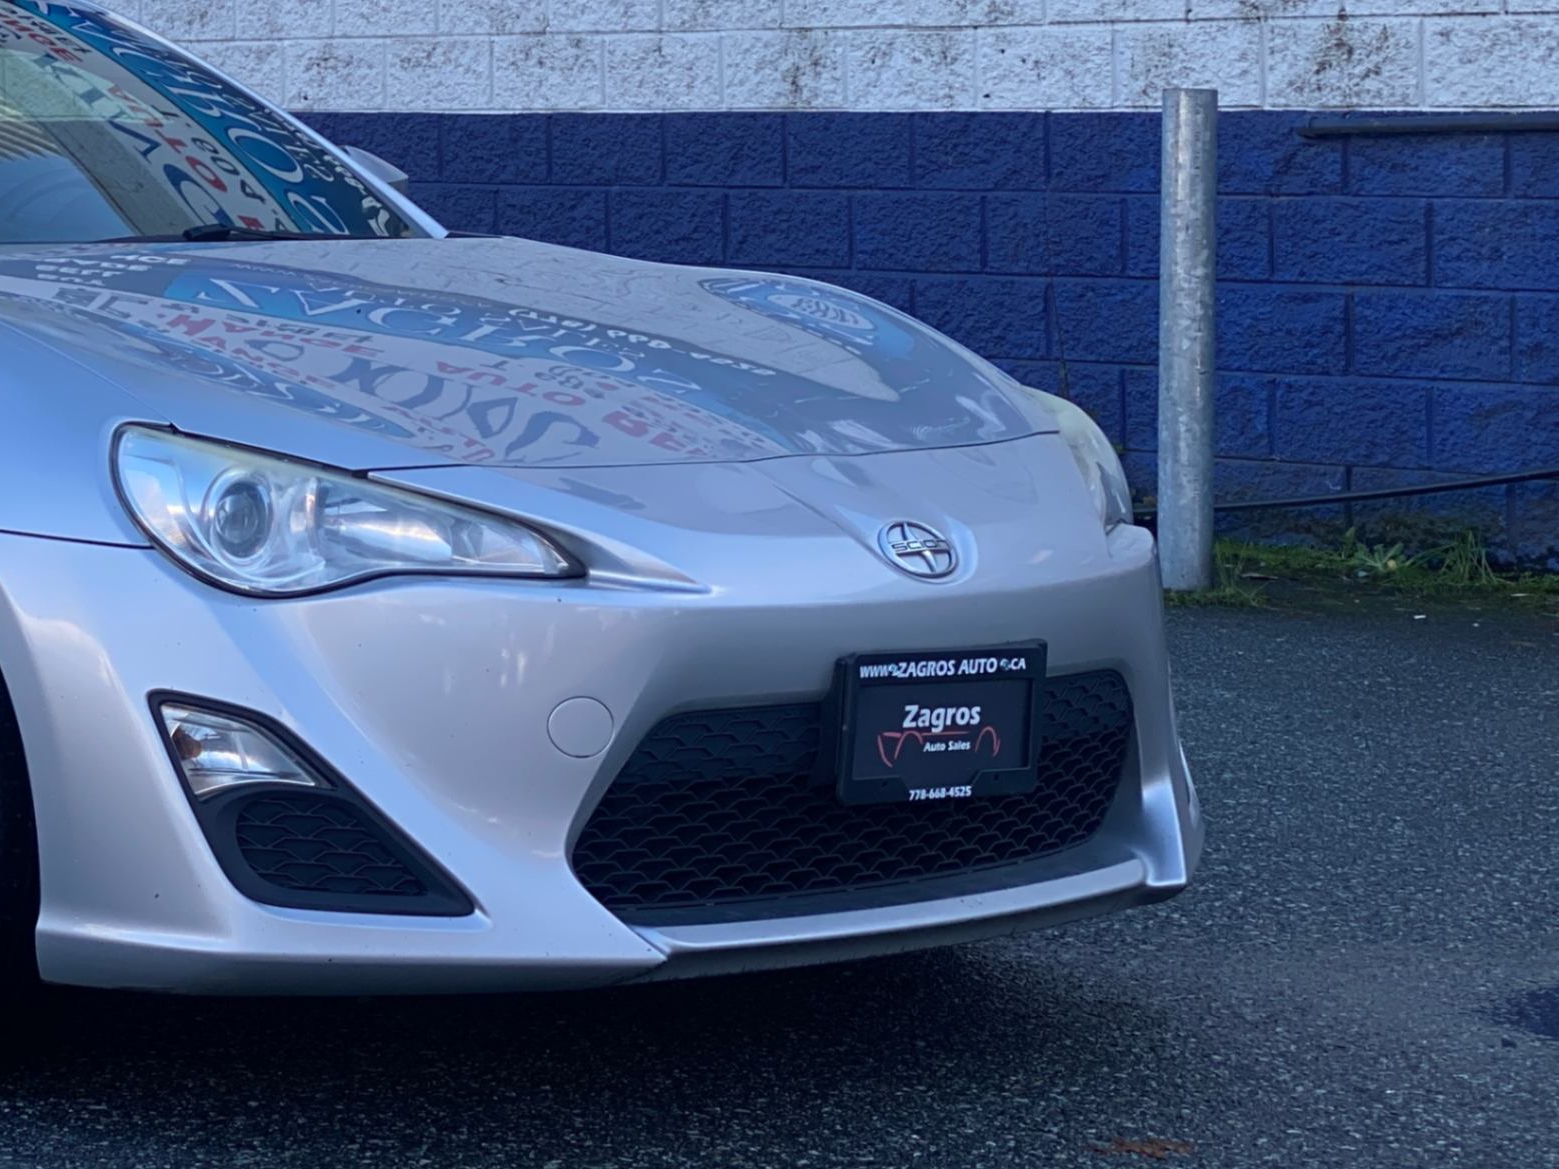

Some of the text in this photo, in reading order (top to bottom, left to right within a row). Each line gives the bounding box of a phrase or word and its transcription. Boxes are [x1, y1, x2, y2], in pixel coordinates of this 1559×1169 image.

[957, 658, 998, 675] AUTO
[902, 705, 981, 732] Zagros
[923, 740, 971, 752] Auto Sales
[908, 785, 972, 801] 778-668-4525
